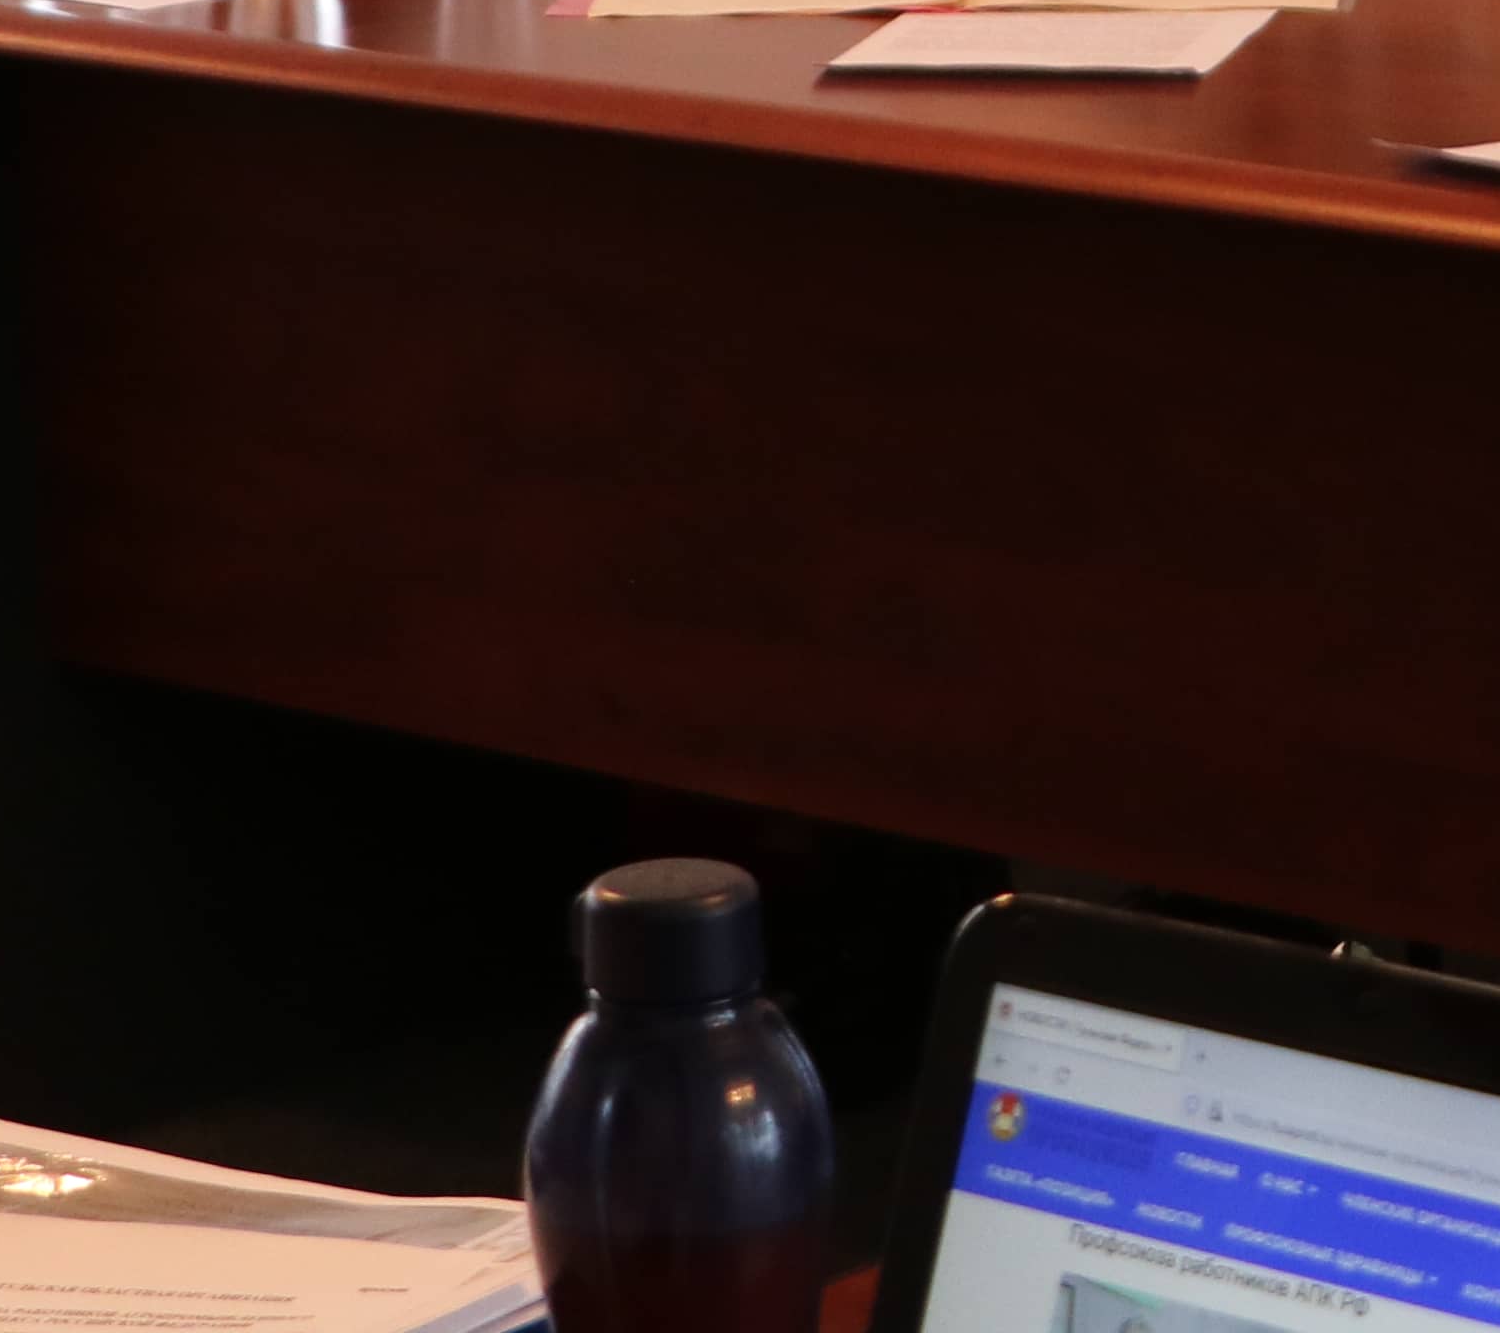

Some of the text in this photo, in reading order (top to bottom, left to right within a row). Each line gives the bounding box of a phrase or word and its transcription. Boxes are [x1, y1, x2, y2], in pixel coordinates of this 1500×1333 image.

[1069, 1222, 1370, 1317] Профсоюза работников АПК РФ
